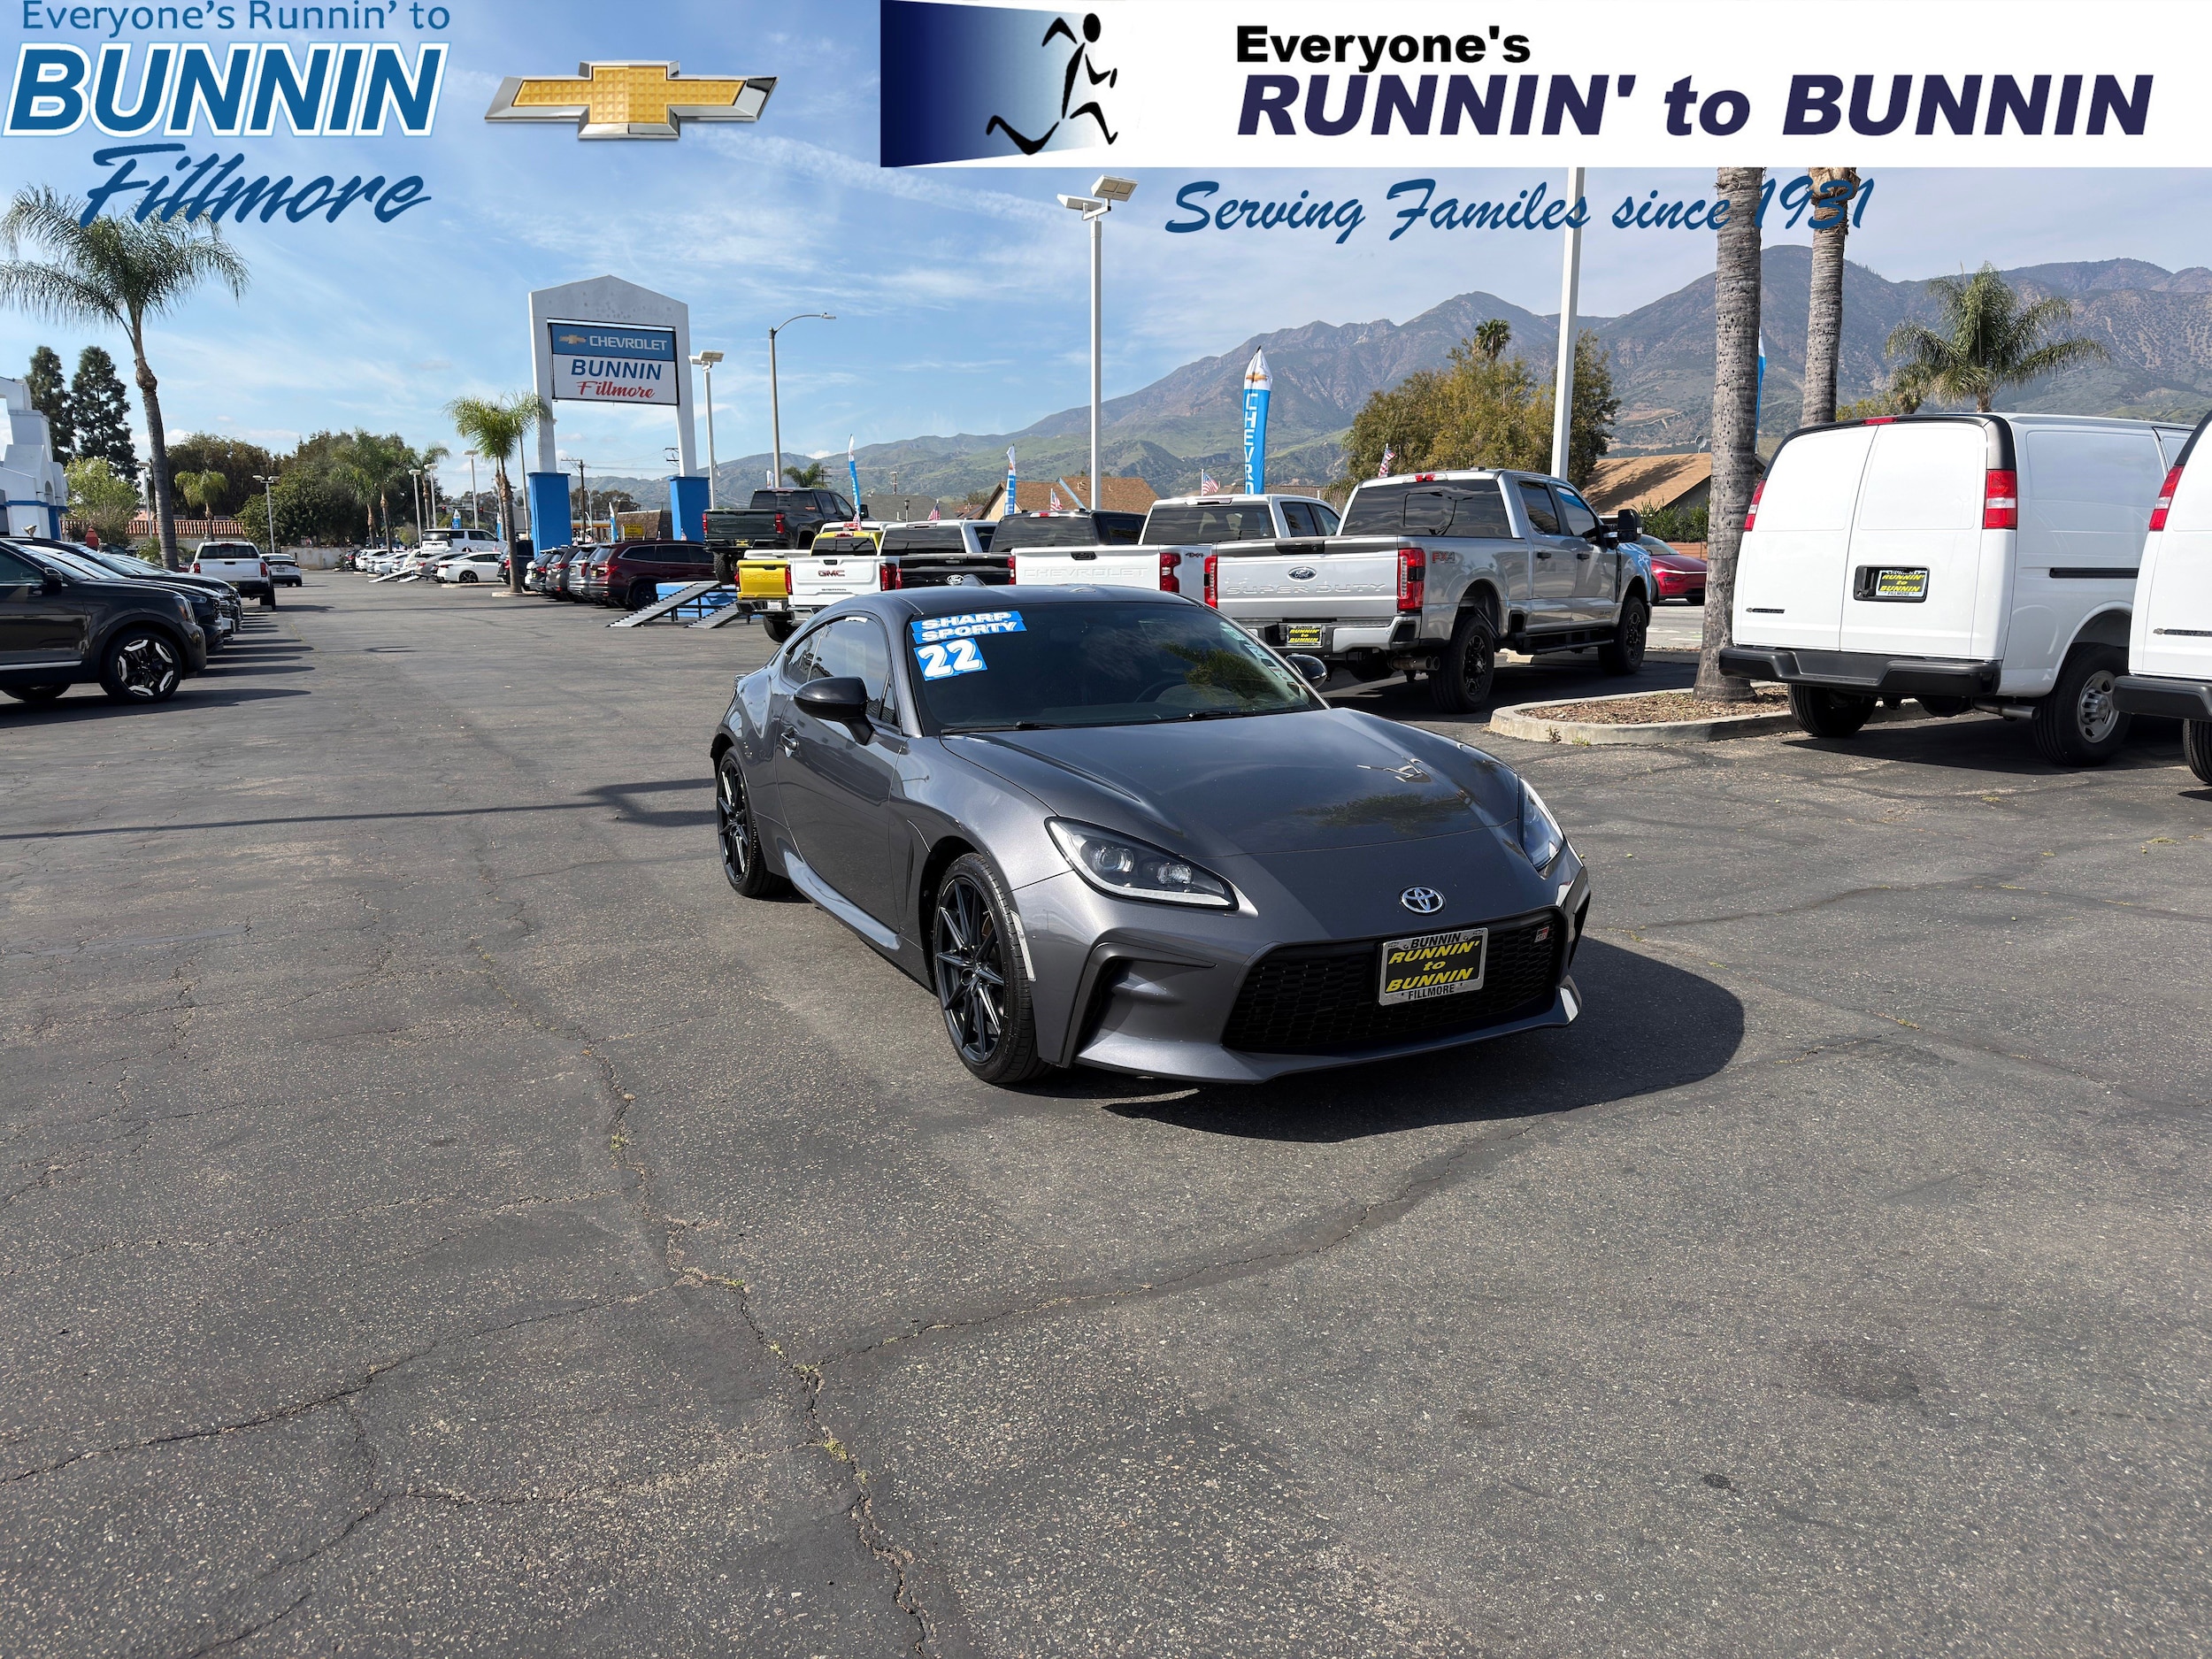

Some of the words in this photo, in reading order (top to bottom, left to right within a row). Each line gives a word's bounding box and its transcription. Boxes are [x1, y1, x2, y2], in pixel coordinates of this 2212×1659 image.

[589, 335, 667, 351] CHEVROLET
[571, 358, 662, 380] BUNNIN
[576, 380, 656, 399] Fillmore
[1244, 393, 1258, 495] CHEVRO
[1024, 567, 1148, 579] CHEVROLET
[1226, 585, 1309, 595] SUPER
[1316, 584, 1386, 593] DUTY
[922, 611, 1012, 630] SHARP
[922, 621, 1017, 642] SPORTY
[918, 639, 982, 678] 22
[1410, 933, 1462, 949] BUNNIN
[1388, 941, 1480, 964] RUNNIN'
[1423, 961, 1446, 971] to
[1385, 967, 1474, 992] BUNNIN
[1408, 985, 1455, 1000] FILLMORE
